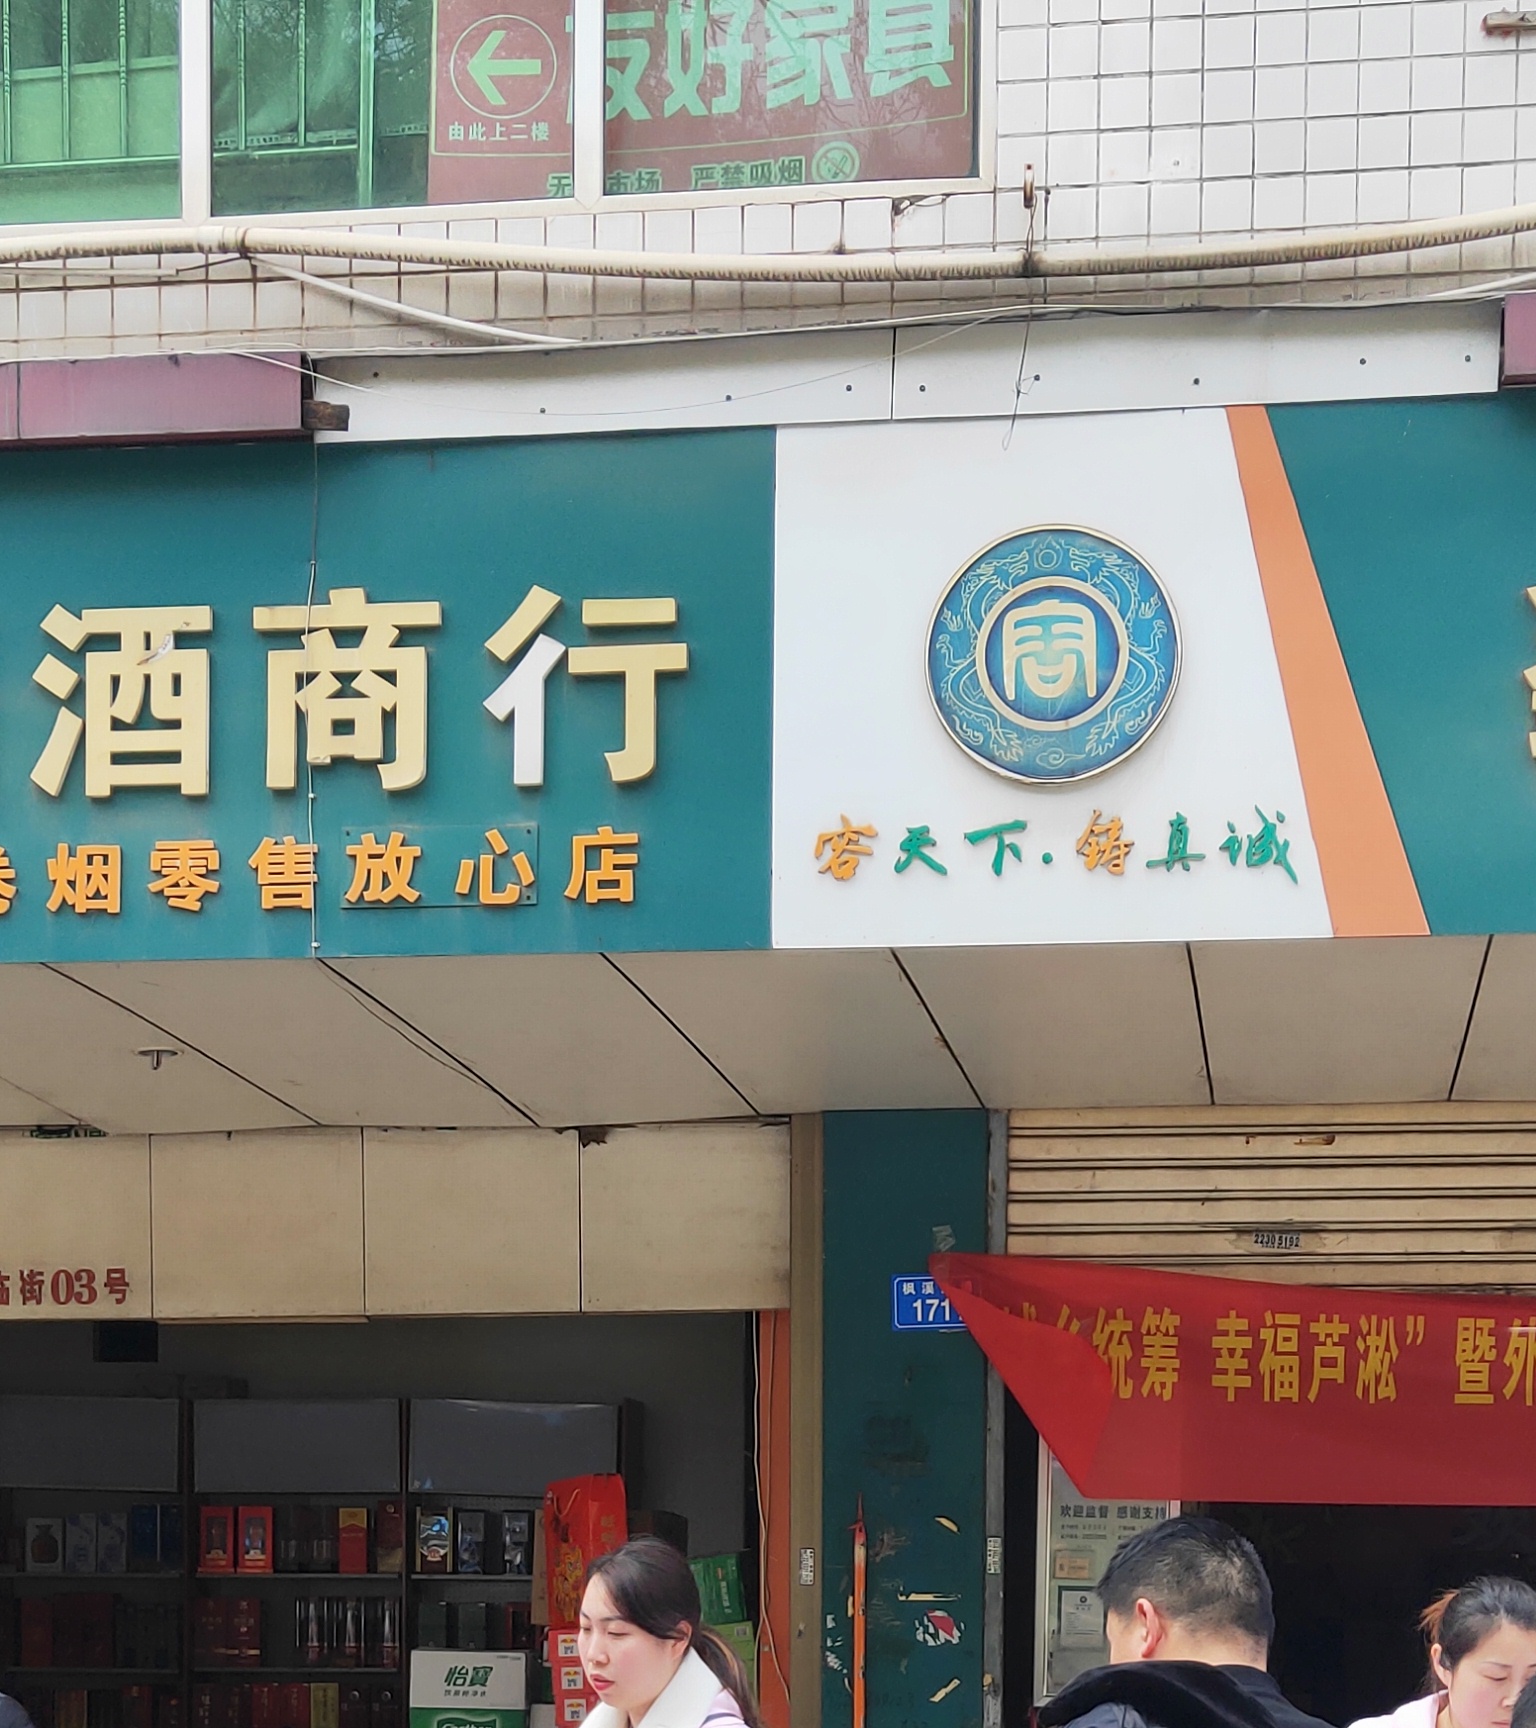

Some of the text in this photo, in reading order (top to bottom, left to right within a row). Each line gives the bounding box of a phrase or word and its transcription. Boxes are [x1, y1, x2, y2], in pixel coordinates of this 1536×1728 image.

[448, 121, 550, 143] 由此上二楼
[548, 158, 804, 196] 无市场 严禁吸烟
[902, 1281, 945, 1295] 枫溪
[913, 1298, 964, 1322] 171
[1060, 1504, 1109, 1519] 欢迎监督
